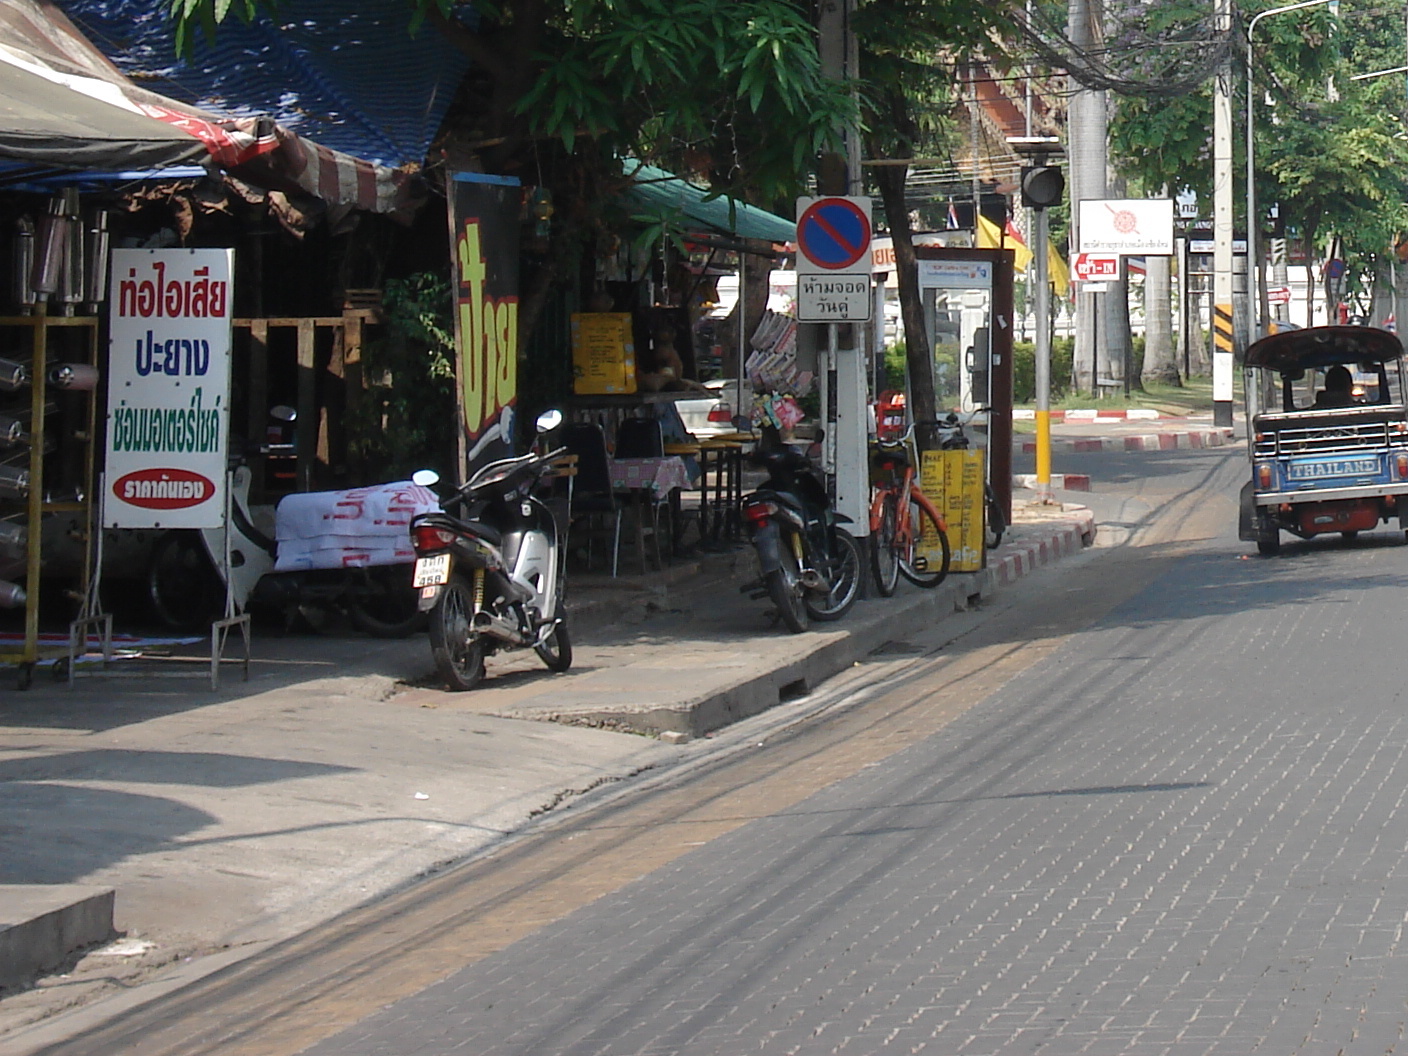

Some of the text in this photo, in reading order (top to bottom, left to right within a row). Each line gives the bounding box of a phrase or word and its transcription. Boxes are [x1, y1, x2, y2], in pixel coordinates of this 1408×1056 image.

[118, 261, 227, 318] ท่อไอเสีย
[803, 276, 866, 294] ห้ามจอด
[816, 296, 848, 319] วันคู่
[458, 216, 519, 439] ป้าย
[134, 329, 209, 377] ปะยาง
[1292, 460, 1376, 477] THAILAND
[123, 474, 205, 500] ราคากันเอง
